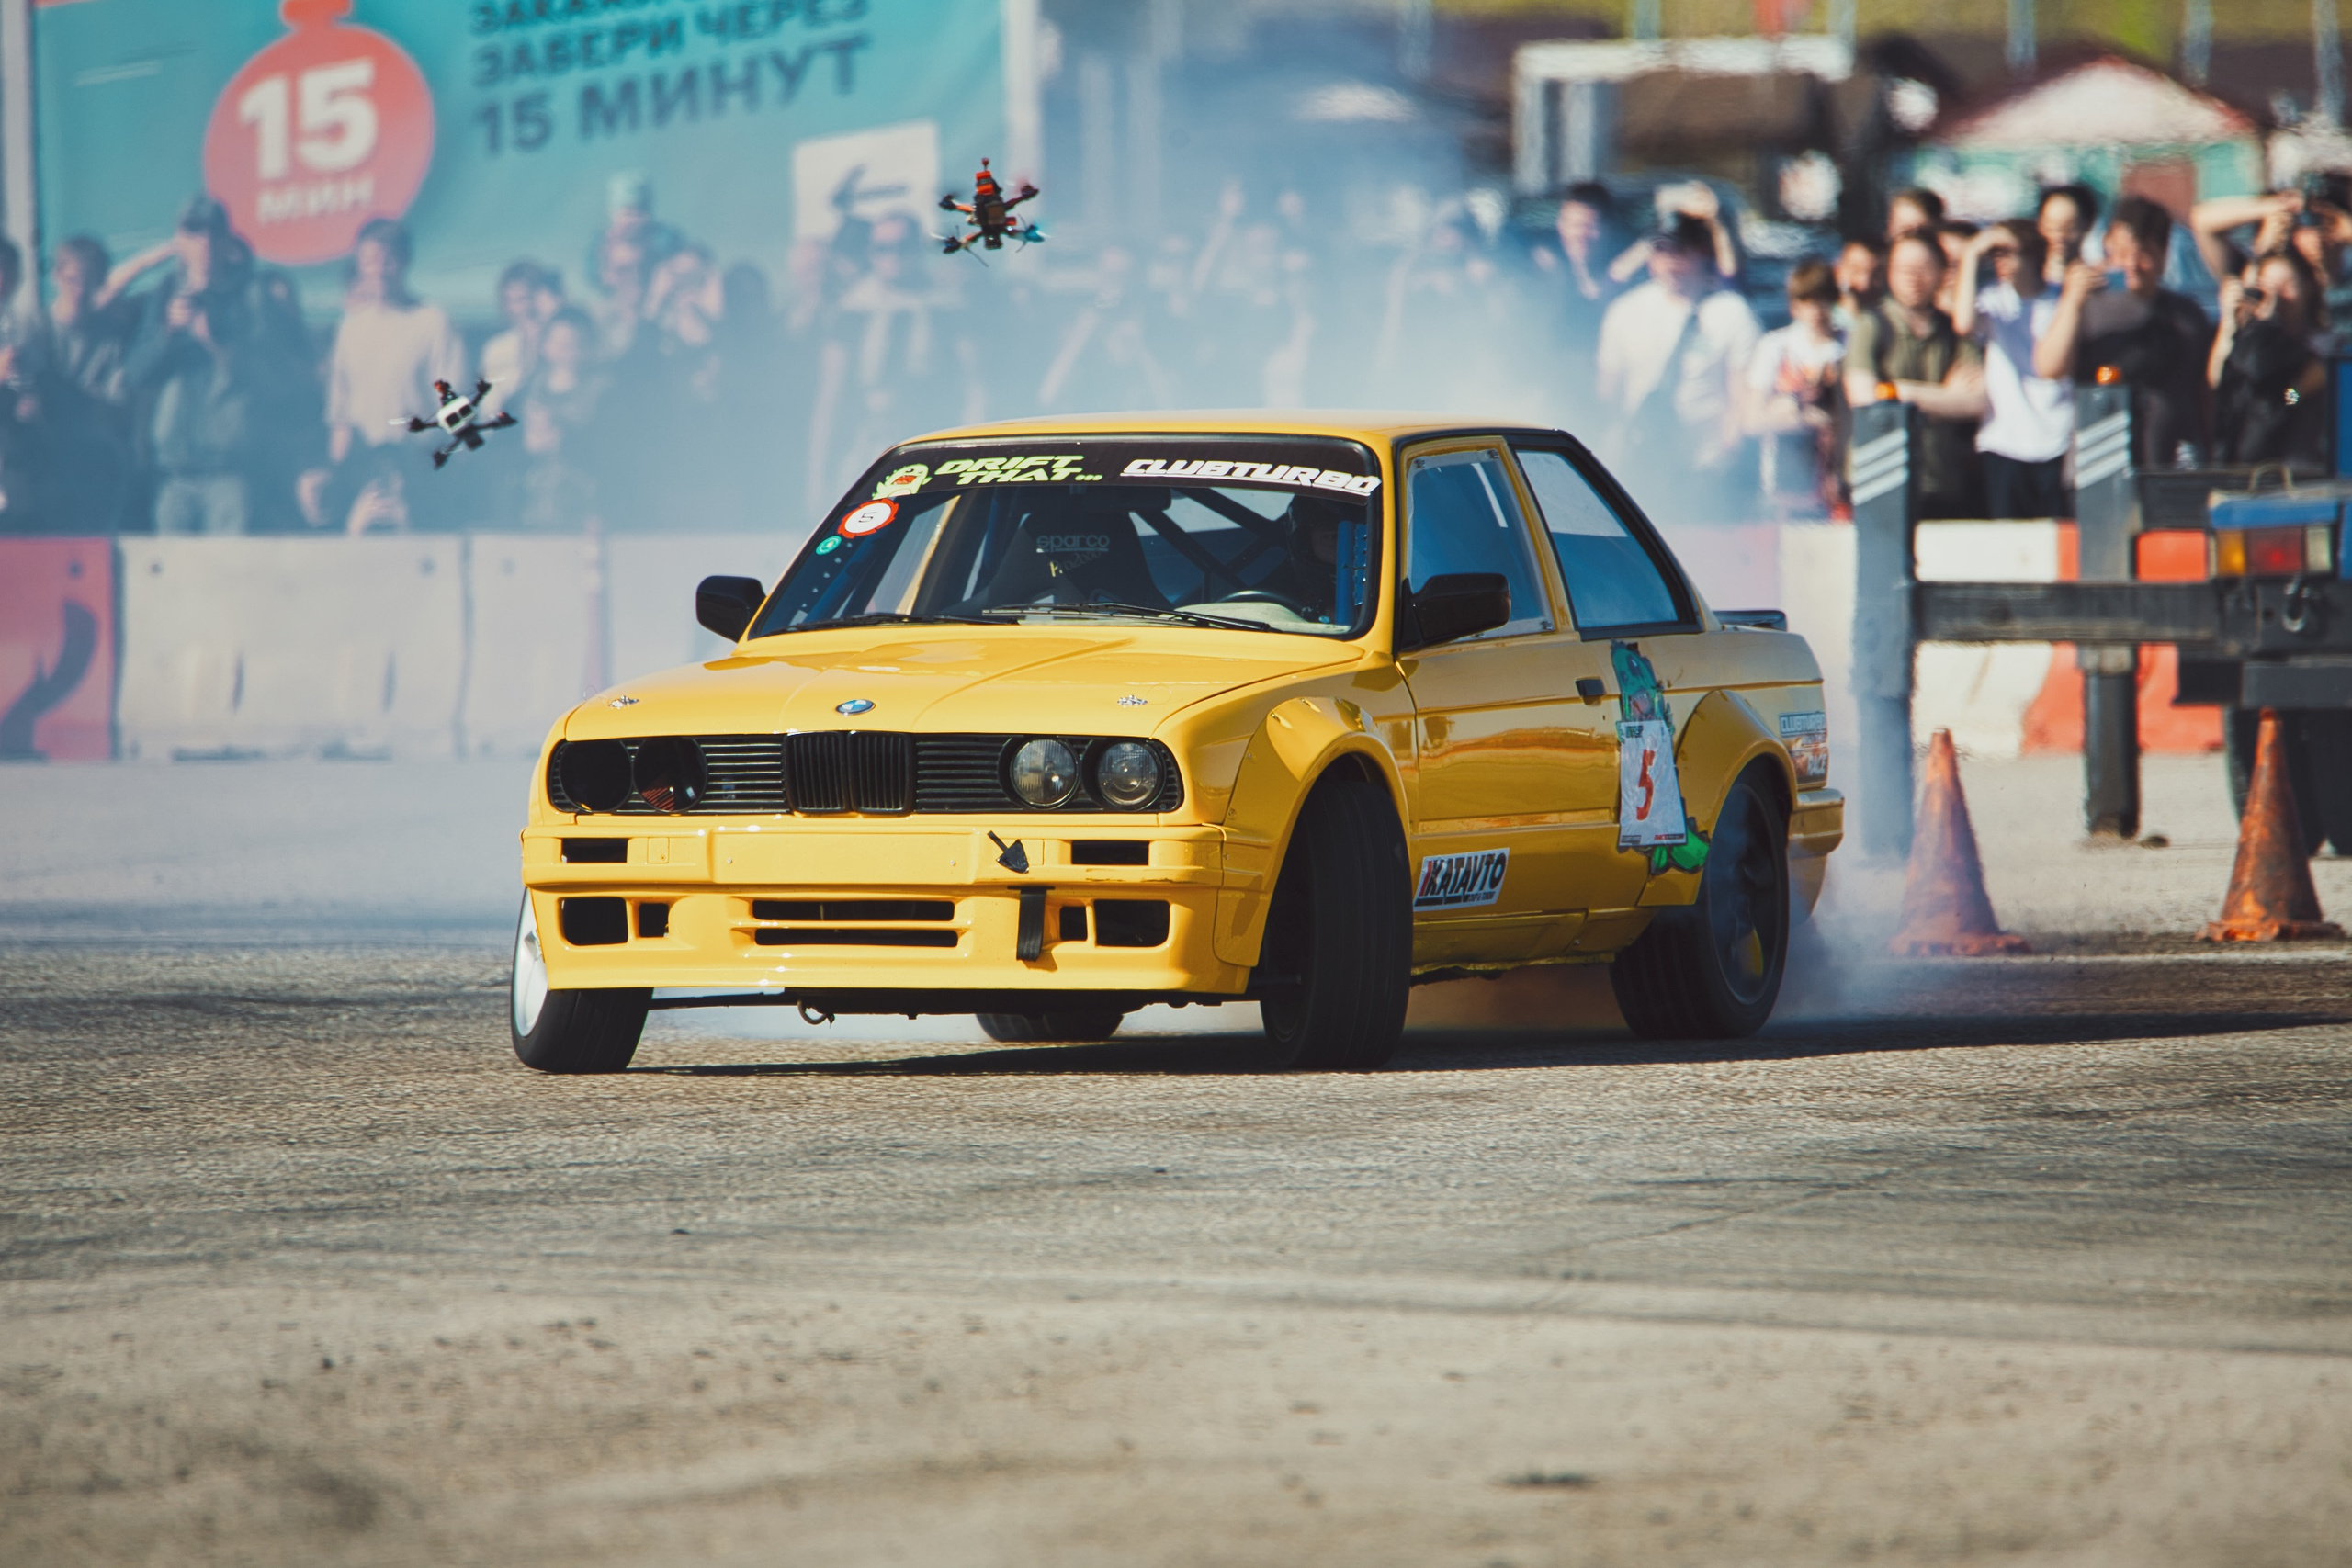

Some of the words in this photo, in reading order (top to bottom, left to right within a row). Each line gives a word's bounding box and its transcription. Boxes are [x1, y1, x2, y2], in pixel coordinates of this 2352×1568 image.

[470, 17, 685, 87] ЗАБЕРИ
[693, 0, 871, 44] ЧЕРЕЗ
[240, 57, 378, 177] 15
[469, 92, 552, 155] 15
[576, 31, 871, 141] МИНУТ
[257, 175, 374, 223] МИН
[934, 455, 1085, 476] DRIFT
[1120, 459, 1382, 496] CLUBTURBO
[1035, 535, 1111, 553] sparco
[1635, 749, 1656, 821] 5
